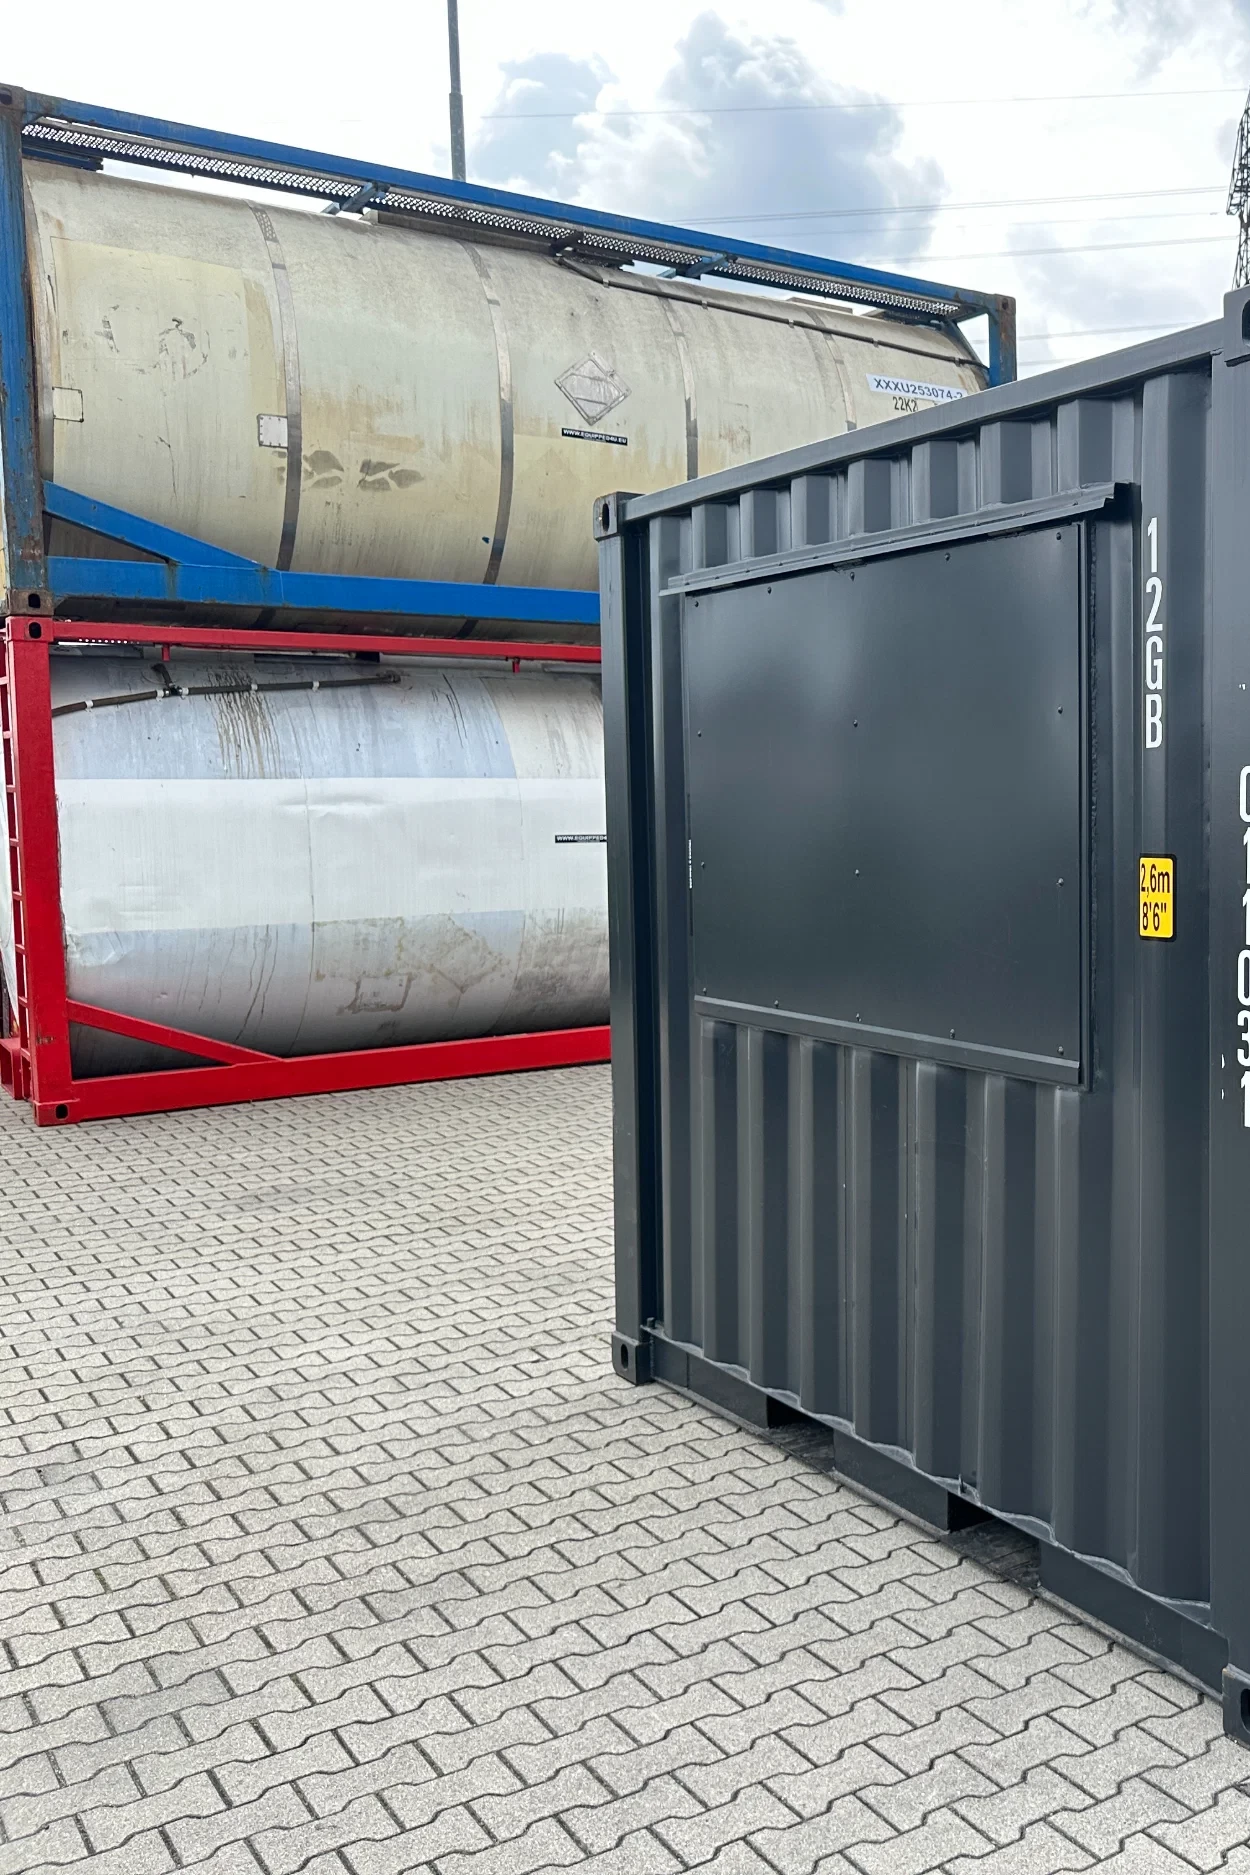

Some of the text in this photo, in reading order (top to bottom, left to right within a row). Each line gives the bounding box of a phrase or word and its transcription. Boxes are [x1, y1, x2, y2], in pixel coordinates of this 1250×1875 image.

[1145, 517, 1164, 749] 12GB
[1141, 863, 1170, 898] 2,6m
[1142, 901, 1167, 931] 8'6"
